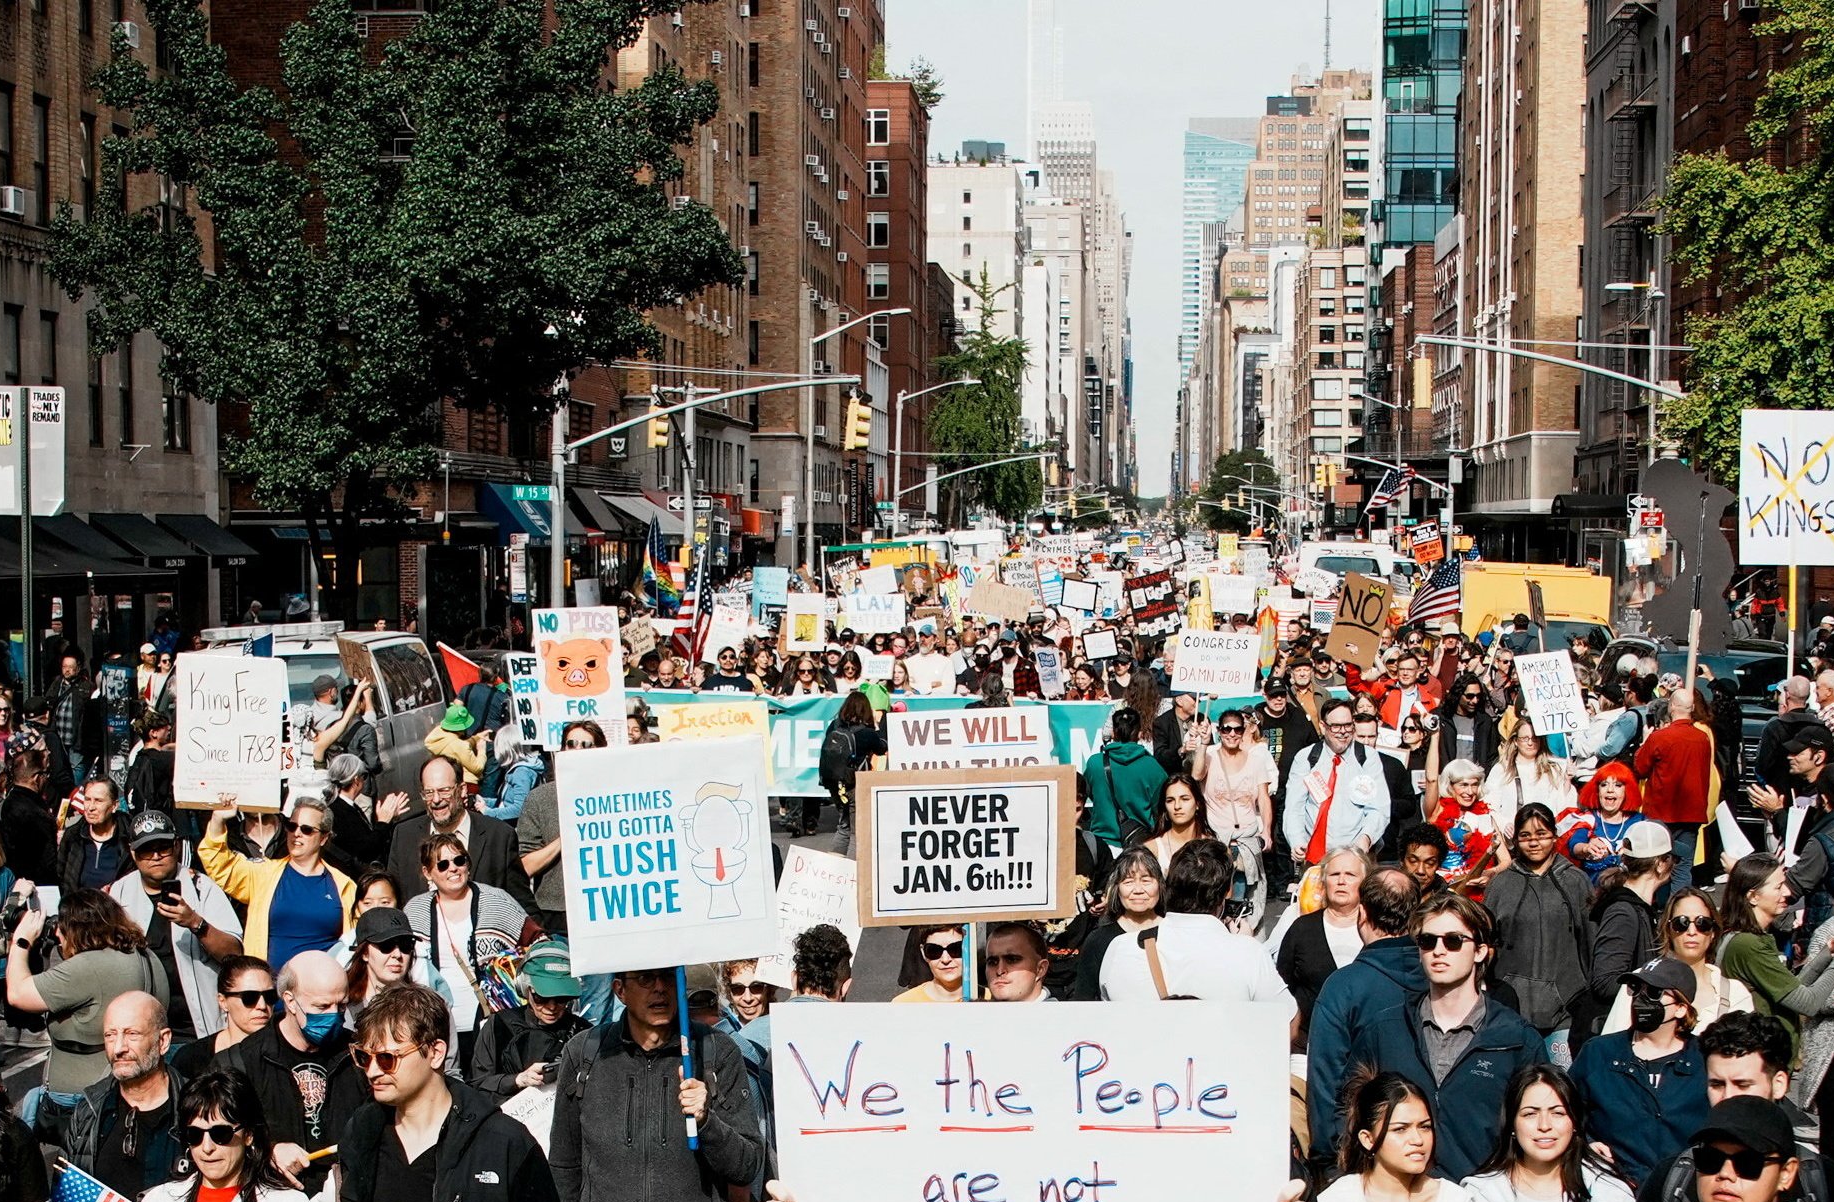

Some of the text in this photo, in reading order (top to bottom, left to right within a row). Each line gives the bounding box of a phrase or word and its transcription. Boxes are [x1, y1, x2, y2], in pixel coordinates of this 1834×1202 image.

[33, 392, 60, 402] TRADES
[1757, 436, 1830, 485] NO
[516, 487, 525, 498] W
[528, 487, 539, 498] 15
[1041, 545, 1072, 554] CRIMES
[1005, 562, 1022, 571] KEEP
[856, 595, 895, 611] LAW
[1339, 583, 1383, 627] NO
[537, 611, 615, 634] NO PIGS
[1183, 636, 1249, 650] CONGRESS
[511, 658, 537, 675] DEF
[1179, 666, 1215, 683] DAMN
[1521, 659, 1562, 672] AMERICA
[1533, 672, 1561, 684] ANTI
[189, 671, 269, 725] King Free
[1528, 682, 1577, 699] FASCIST
[566, 698, 599, 716] FOR
[1543, 701, 1569, 711] SINCE
[902, 715, 1038, 747] WE WILL
[1542, 711, 1578, 731] 1776
[187, 726, 229, 764] Since
[237, 735, 275, 764] 1783
[574, 789, 673, 817] SOMETIMES
[908, 793, 1009, 826] NEVER
[576, 814, 674, 841] YOU GOTTA
[900, 827, 1020, 861] FORGET
[579, 838, 678, 881] FLUSH
[794, 855, 857, 889] Diversit
[893, 861, 1034, 895] JAN. 6th!!!
[582, 878, 682, 922] TWICE
[788, 1040, 1238, 1129] We the People
